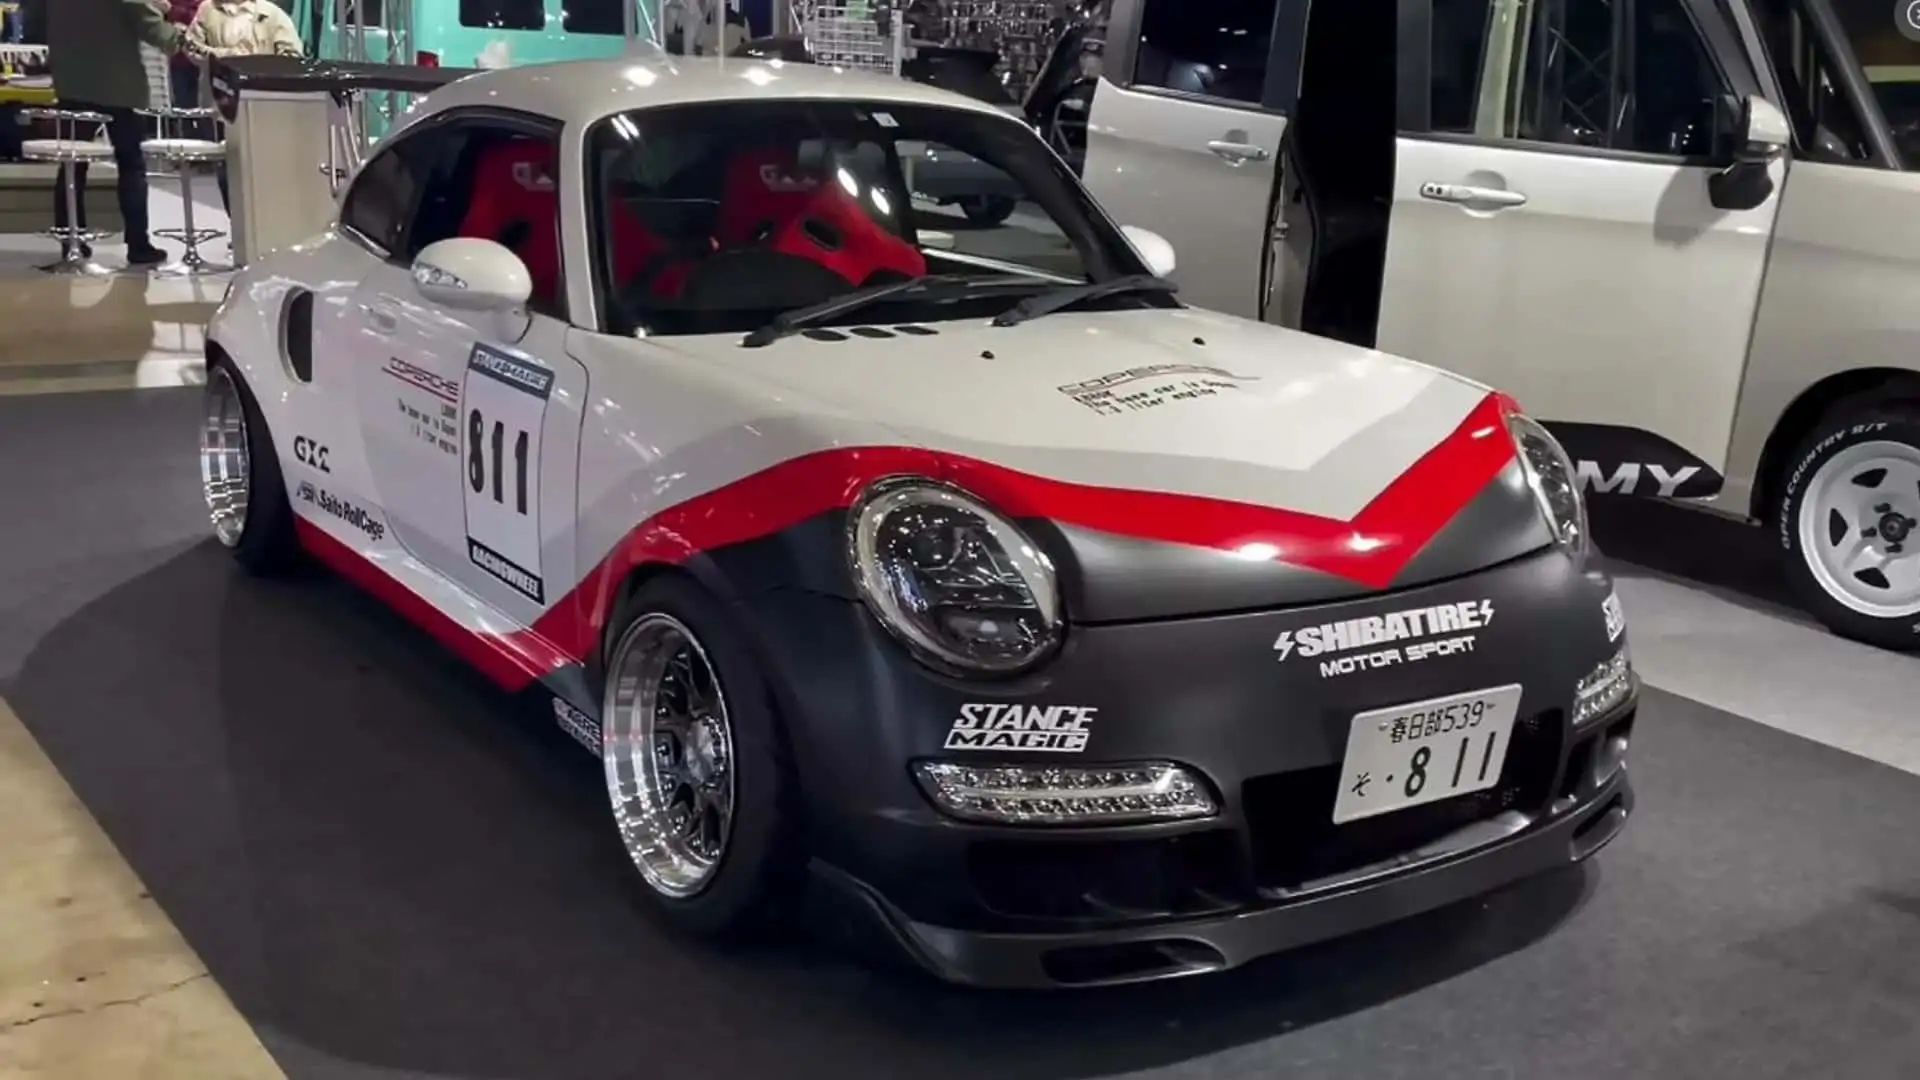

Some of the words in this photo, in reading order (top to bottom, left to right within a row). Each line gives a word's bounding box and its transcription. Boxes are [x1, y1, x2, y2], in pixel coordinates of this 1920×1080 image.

[469, 408, 529, 516] 811
[1786, 429, 1846, 495] COUNTRY
[1295, 601, 1483, 657] SHIBATIRE
[1319, 647, 1402, 678] MOTOR
[1407, 635, 1477, 663] SPORT
[947, 731, 1088, 751] MAGIC
[952, 703, 1099, 732] STANCE
